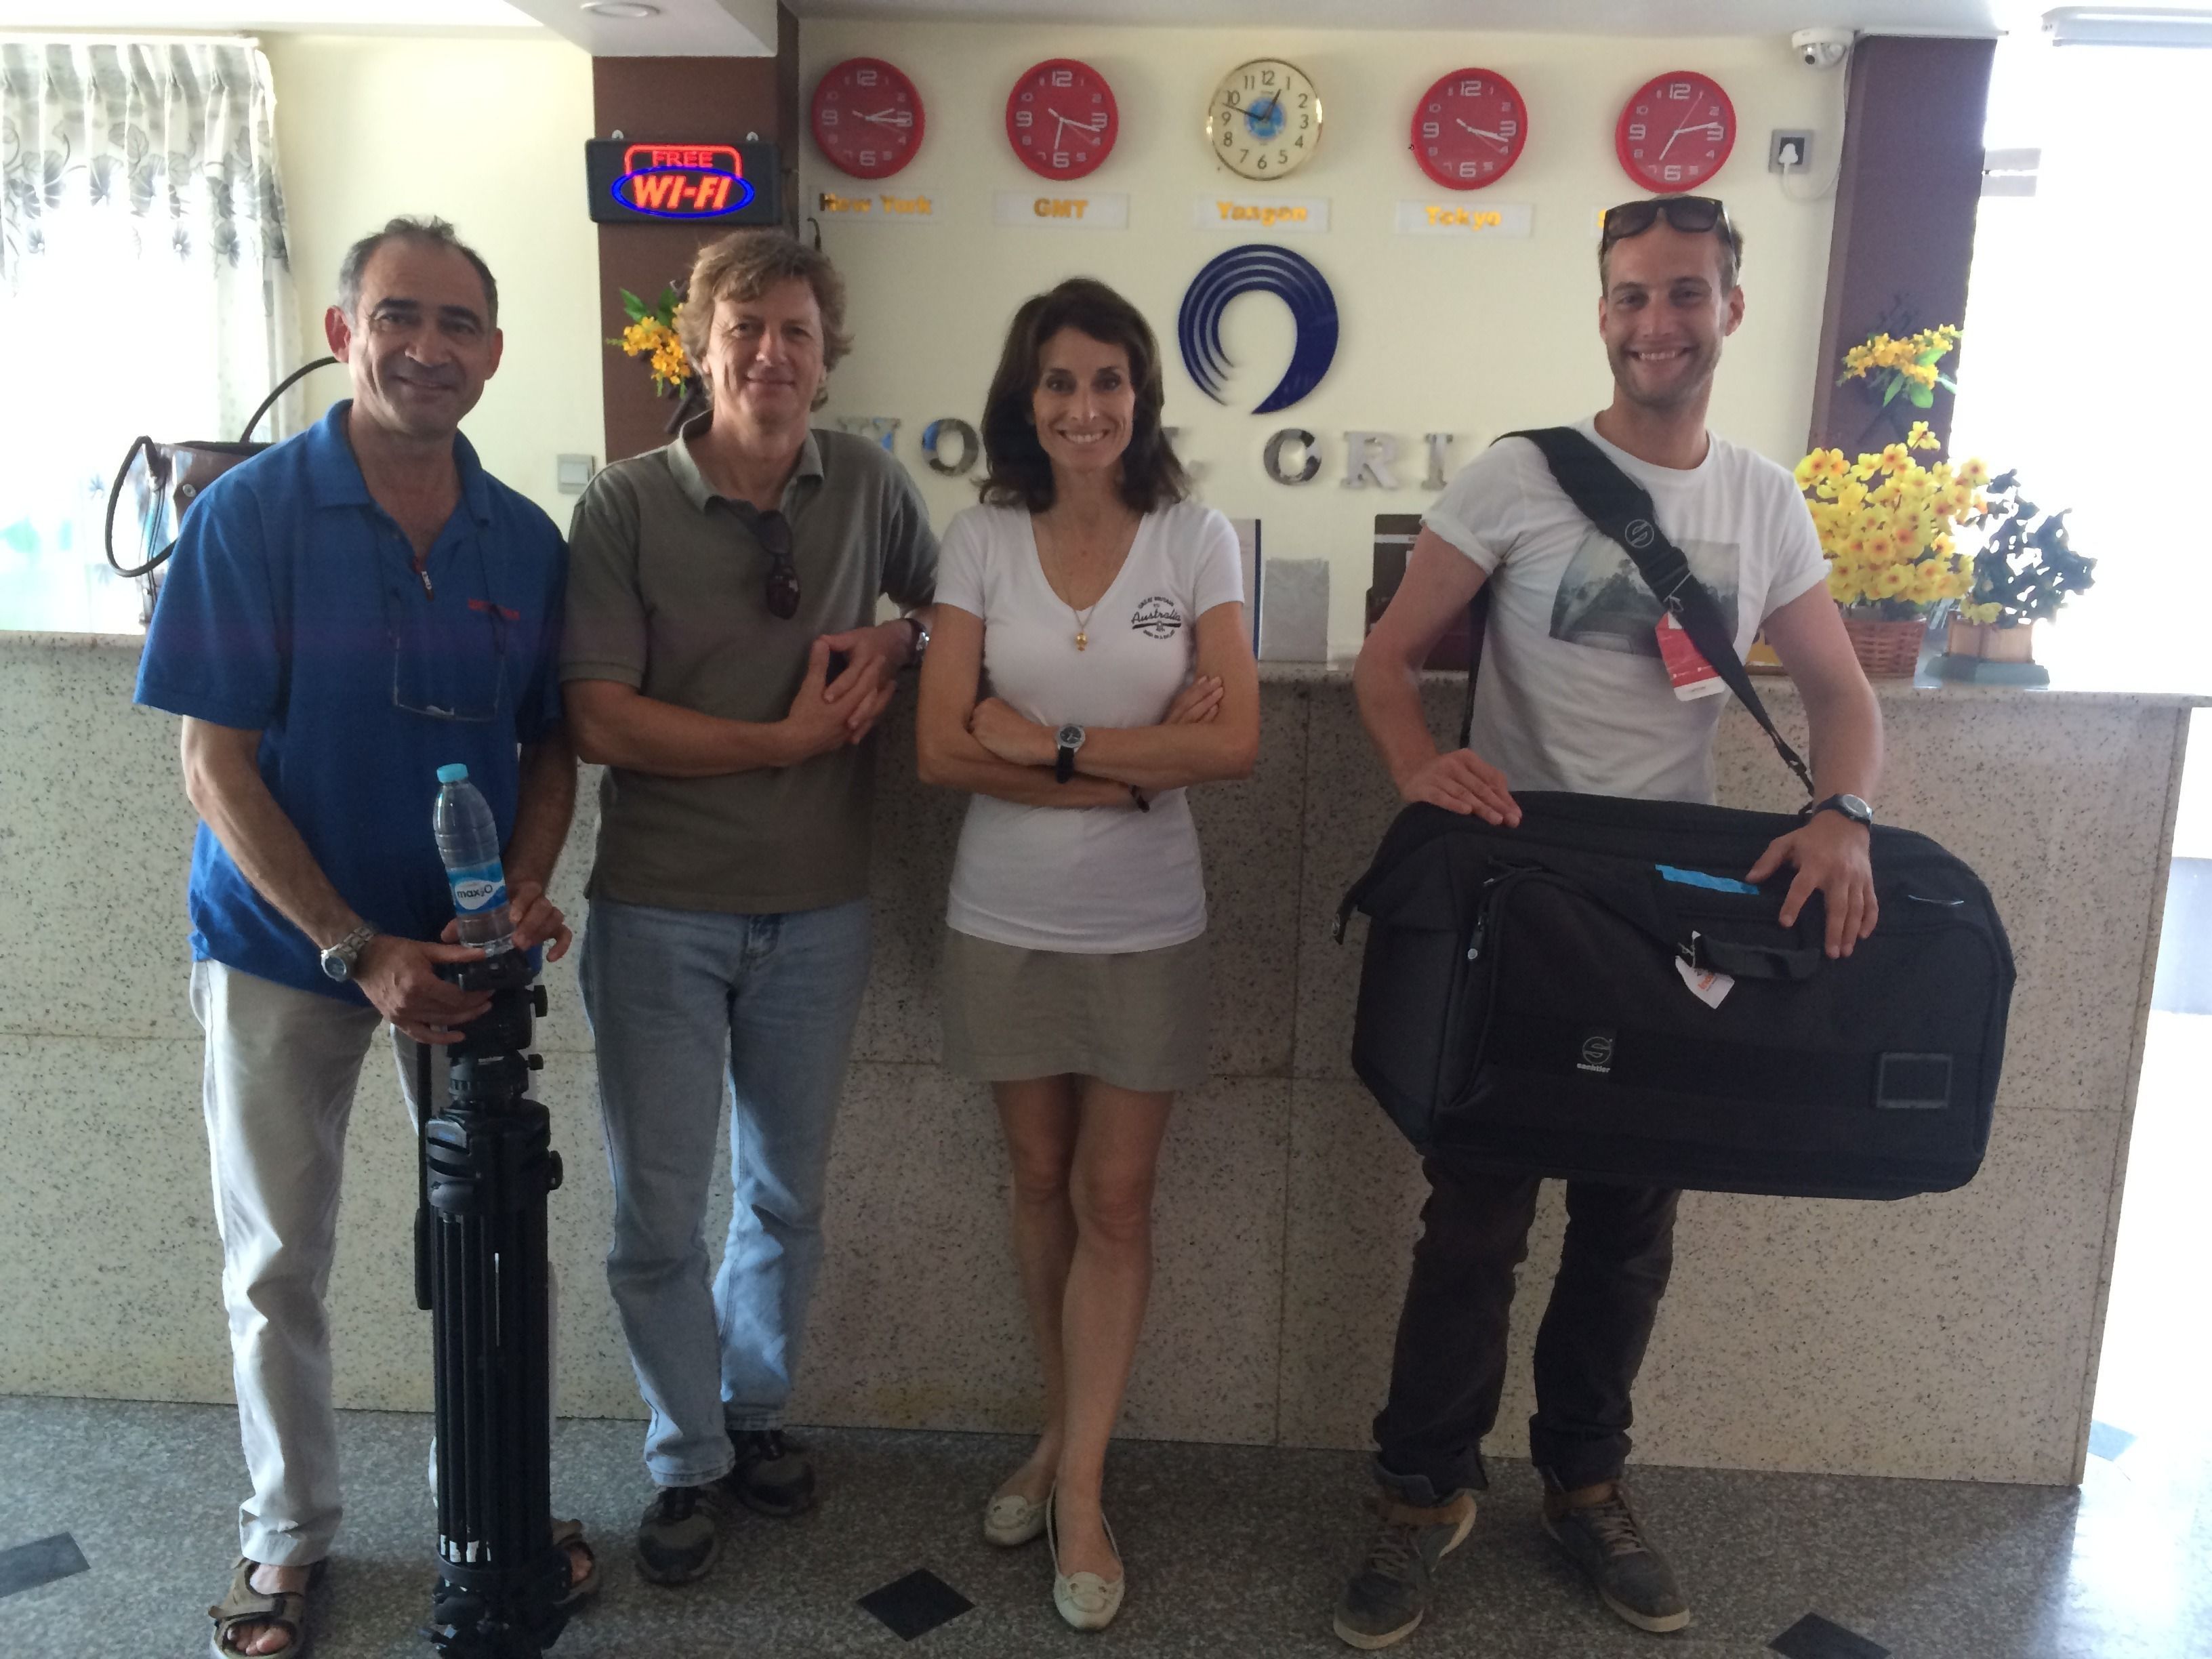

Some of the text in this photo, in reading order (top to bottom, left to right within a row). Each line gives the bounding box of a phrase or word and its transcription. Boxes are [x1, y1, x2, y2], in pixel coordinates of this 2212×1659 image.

[857, 70, 878, 86] 12
[1052, 70, 1072, 87] 12
[1244, 75, 1255, 89] 11
[1261, 70, 1275, 85] 12
[1460, 81, 1481, 96] 12
[1669, 83, 1691, 99] 12
[1227, 90, 1240, 105] 10
[1298, 94, 1308, 108] 2
[821, 110, 838, 125] 9
[1016, 110, 1032, 127] 9
[1092, 112, 1107, 128] 3
[1222, 112, 1231, 126] 9
[1300, 114, 1309, 129] 3
[1423, 122, 1439, 138] 9
[1500, 121, 1517, 136] 3
[1629, 124, 1646, 140] 9
[1706, 125, 1724, 141] 3
[1223, 131, 1233, 147] 8
[1295, 135, 1303, 148] 4
[653, 150, 714, 167] FREE
[860, 150, 876, 166] 6
[1053, 152, 1069, 168] 6
[1240, 149, 1249, 163] 7
[1257, 155, 1267, 169] 6
[1279, 150, 1288, 164] 5
[1460, 161, 1476, 178] 6
[1664, 165, 1681, 180] 6
[632, 174, 733, 210] WI-FI
[1034, 198, 1088, 219] GMT
[1217, 201, 1307, 227] Yangon
[1426, 206, 1502, 231] Tokyo
